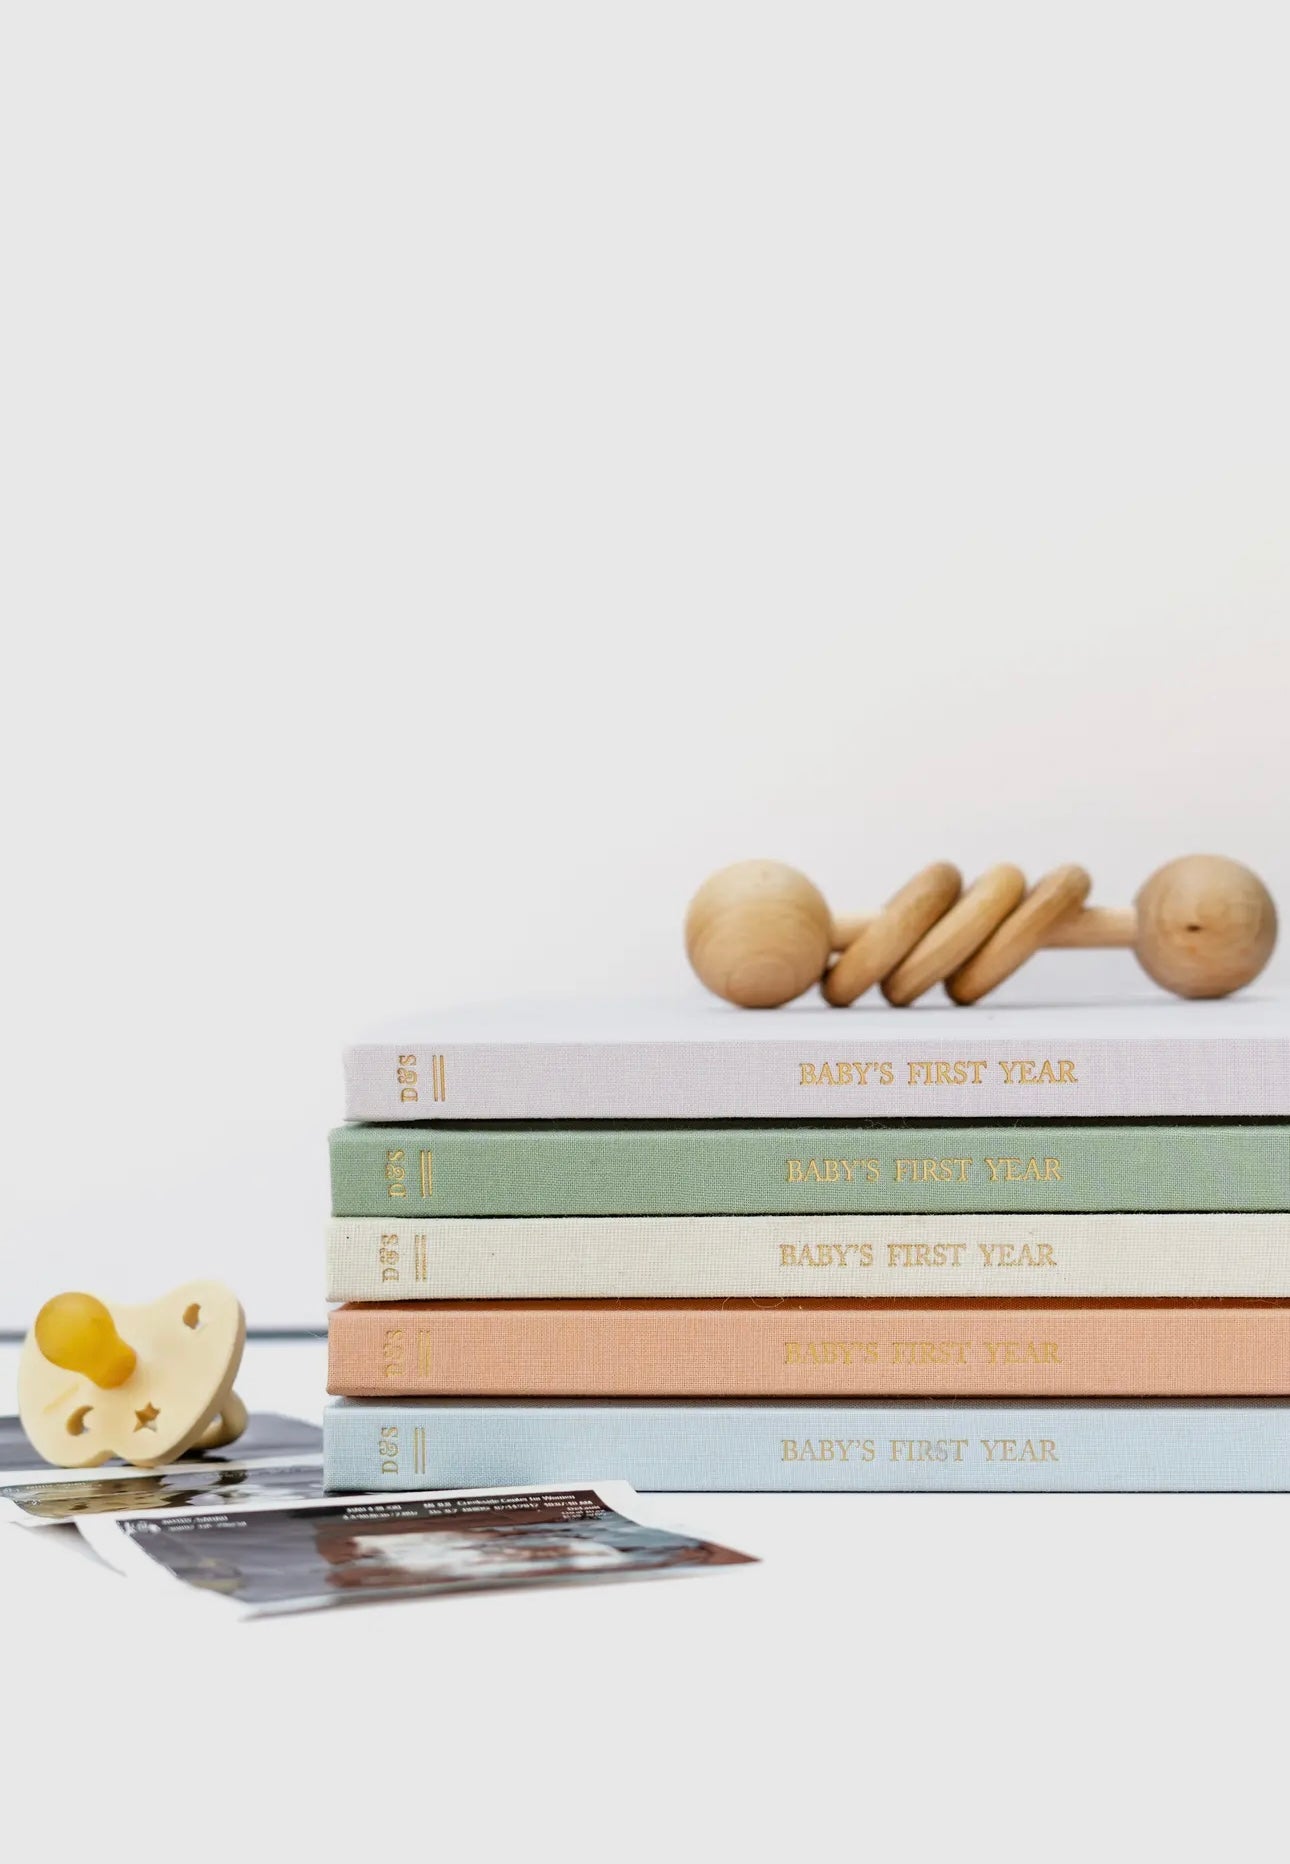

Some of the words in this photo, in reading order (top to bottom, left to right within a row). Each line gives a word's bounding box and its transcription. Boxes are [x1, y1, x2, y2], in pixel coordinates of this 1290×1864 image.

[397, 1054, 418, 1102] D&S
[799, 1061, 894, 1086] BABY'S
[907, 1060, 988, 1086] FIRST
[998, 1059, 1079, 1084] YEAR
[385, 1149, 407, 1198] D&S
[786, 1159, 880, 1183] BABY'S
[895, 1157, 973, 1182] FIRST
[984, 1157, 1064, 1181] YEAR
[379, 1233, 400, 1283] D&S
[779, 1243, 874, 1267] BABY'S
[887, 1243, 967, 1267] FIRST
[979, 1243, 1058, 1267] YEAR
[784, 1341, 879, 1365] BABY'S
[891, 1341, 972, 1365] FIRST
[983, 1341, 1063, 1365] YEAR
[378, 1426, 399, 1475] D&S
[781, 1439, 876, 1463] BABY'S
[888, 1439, 969, 1462] FIRST
[980, 1439, 1060, 1462] YEAR
